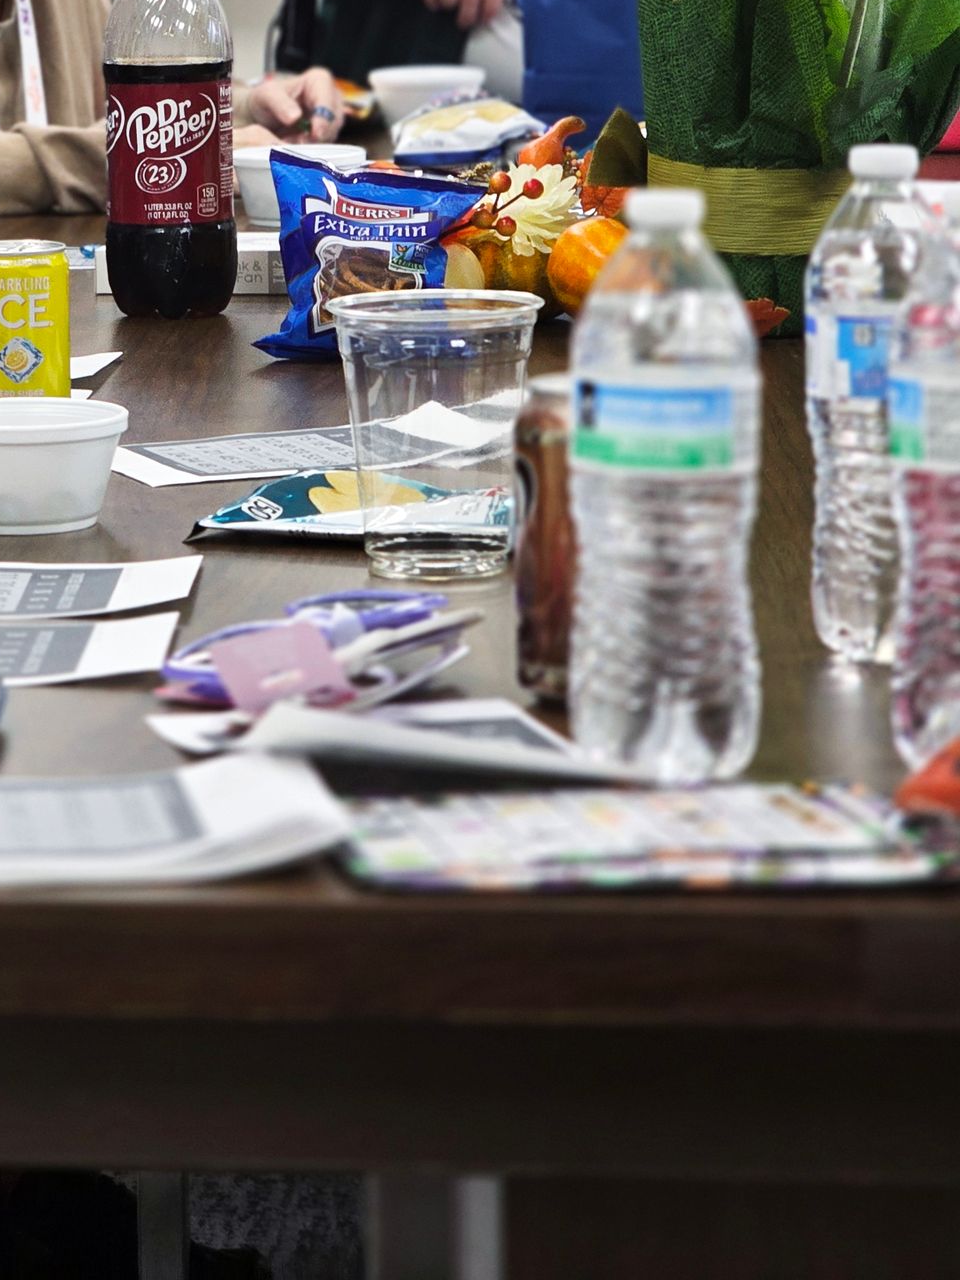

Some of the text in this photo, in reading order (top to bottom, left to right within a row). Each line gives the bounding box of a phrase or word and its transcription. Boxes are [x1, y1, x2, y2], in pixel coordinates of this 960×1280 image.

[156, 98, 192, 128] Dr
[127, 105, 211, 155] Pepper
[148, 165, 169, 184] 23
[202, 187, 214, 198] 150
[148, 203, 164, 211] LITER
[177, 202, 184, 210] FL
[185, 202, 192, 210] OZ
[314, 214, 427, 238] Extra Thin
